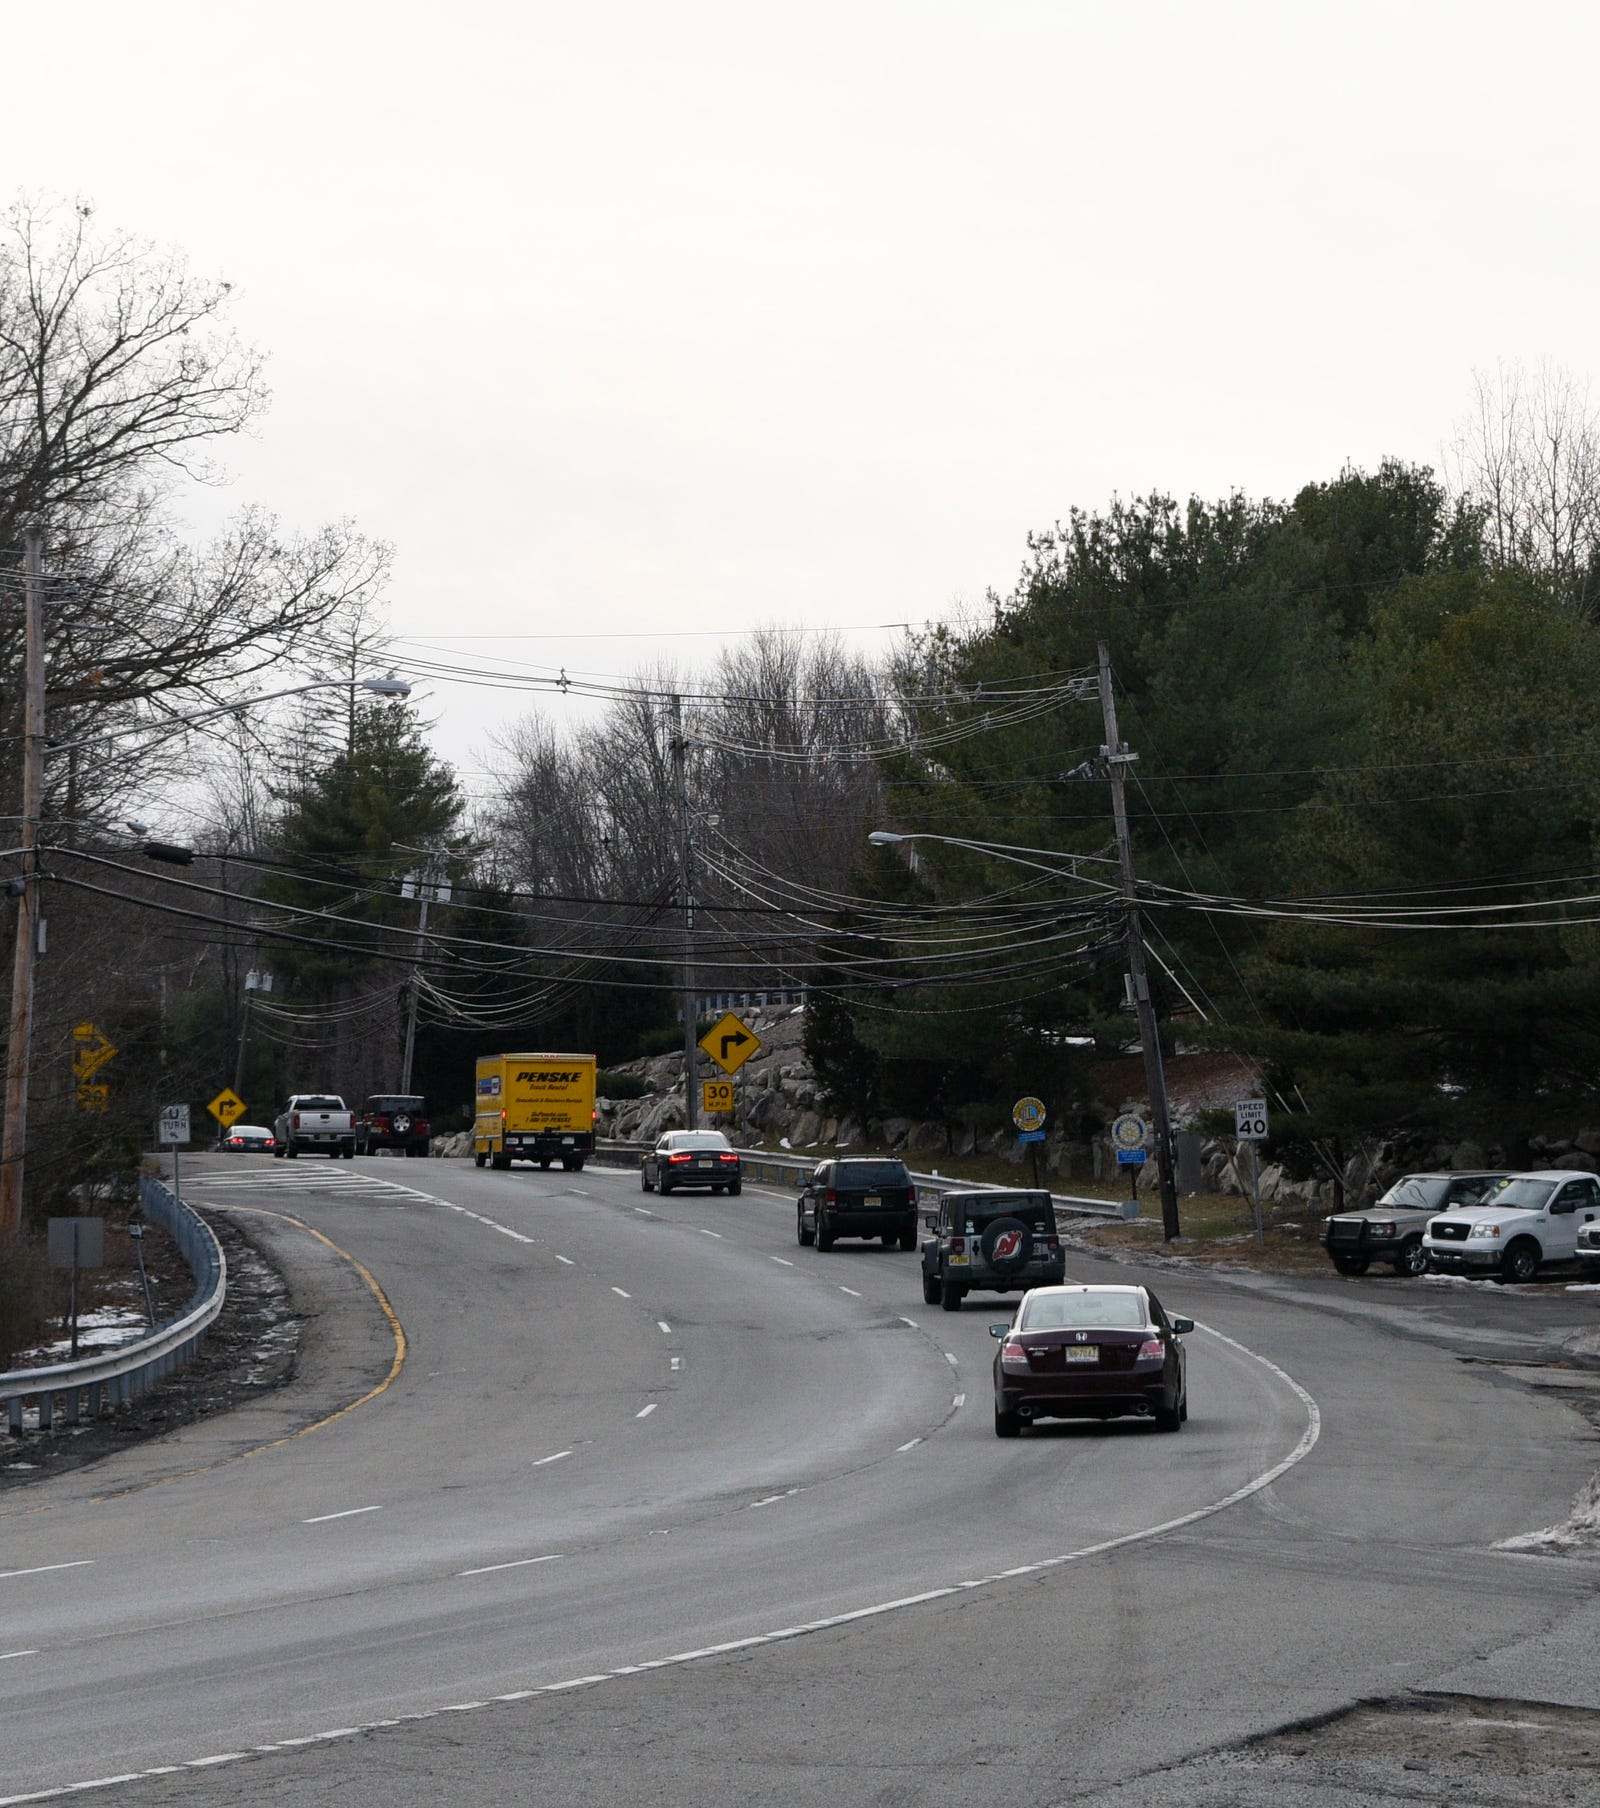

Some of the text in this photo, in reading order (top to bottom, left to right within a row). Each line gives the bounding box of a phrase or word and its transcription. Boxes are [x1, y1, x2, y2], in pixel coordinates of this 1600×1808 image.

[516, 1071, 583, 1082] PENSKE
[707, 1086, 729, 1099] 30
[1237, 1103, 1264, 1111] SPEED
[169, 1108, 179, 1119] U
[1240, 1111, 1262, 1119] LIMIT
[163, 1121, 187, 1129] TURN
[1239, 1119, 1266, 1134] 40
